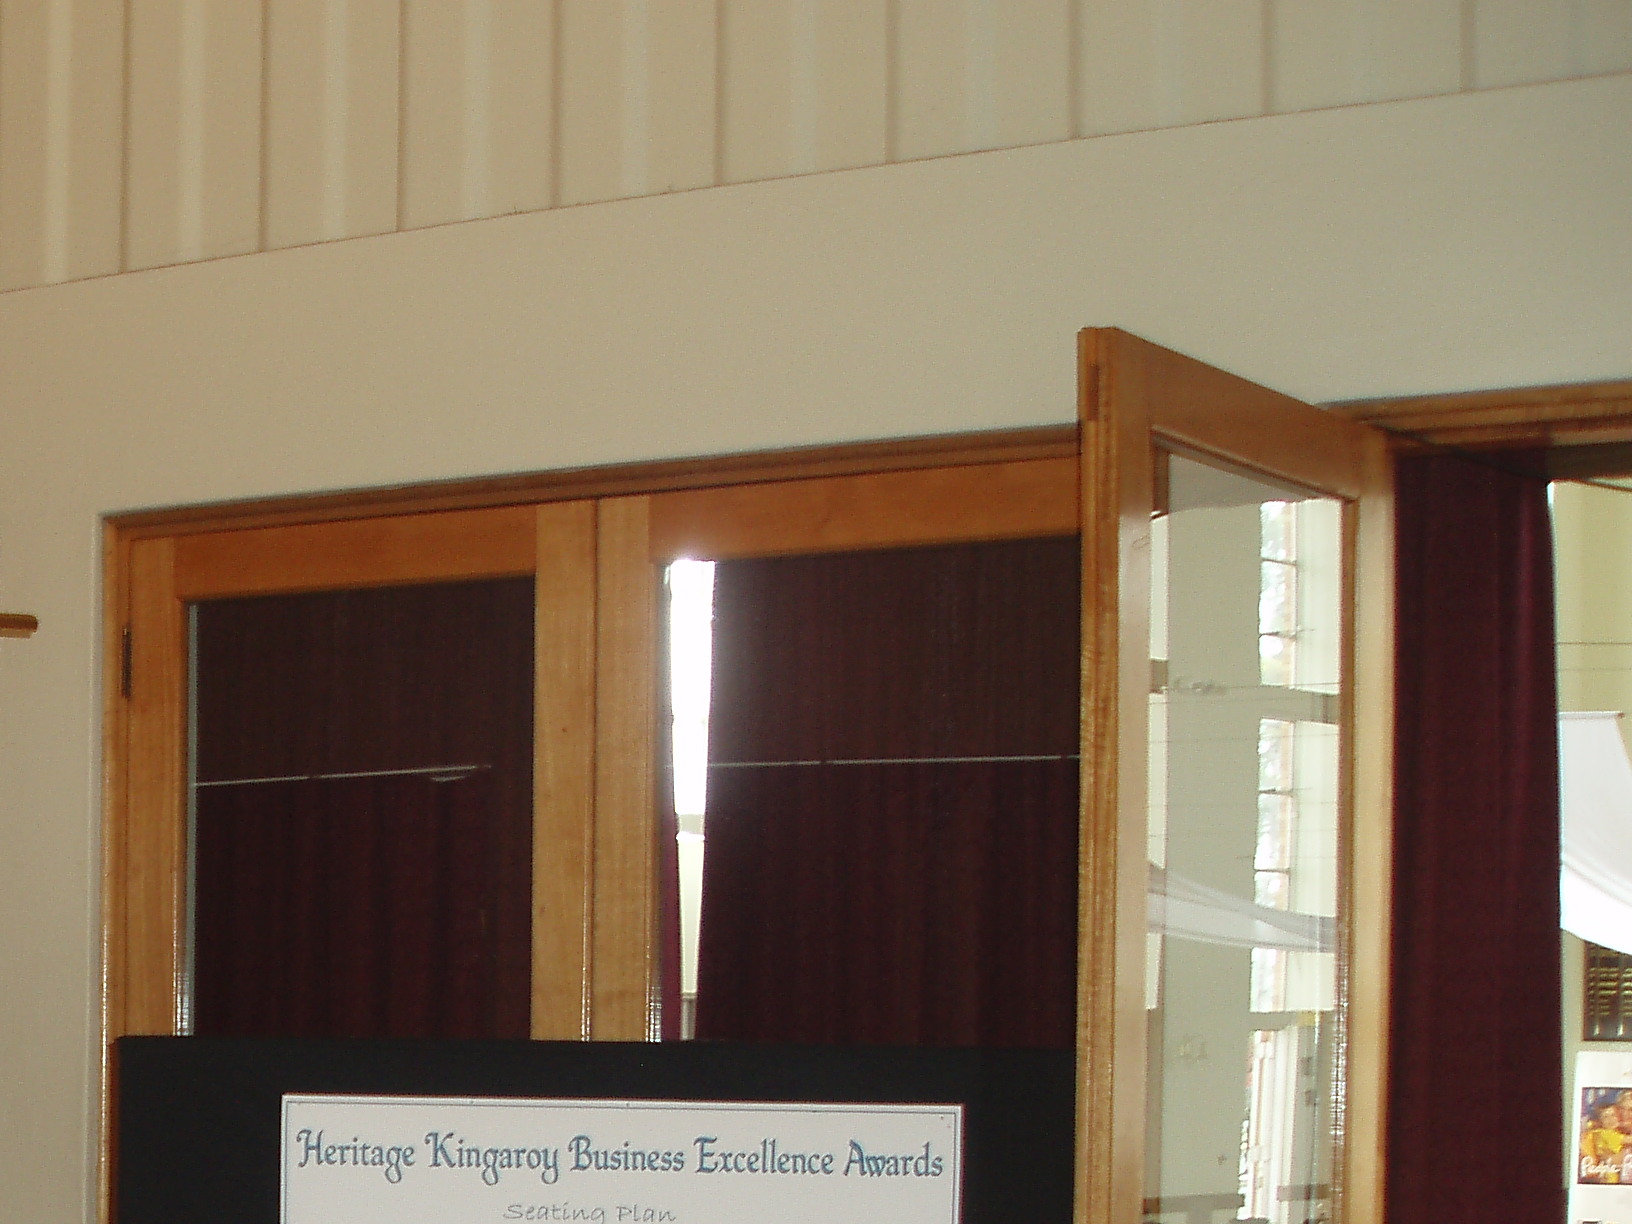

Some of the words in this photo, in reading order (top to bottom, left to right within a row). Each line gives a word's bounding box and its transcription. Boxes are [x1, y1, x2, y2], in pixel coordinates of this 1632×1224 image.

[295, 1128, 416, 1184] Heritage
[423, 1131, 560, 1186] Kingaroy
[567, 1134, 686, 1172] Business
[692, 1135, 835, 1176] Excellence
[842, 1138, 944, 1178] Awards
[615, 1203, 677, 1223] Plan
